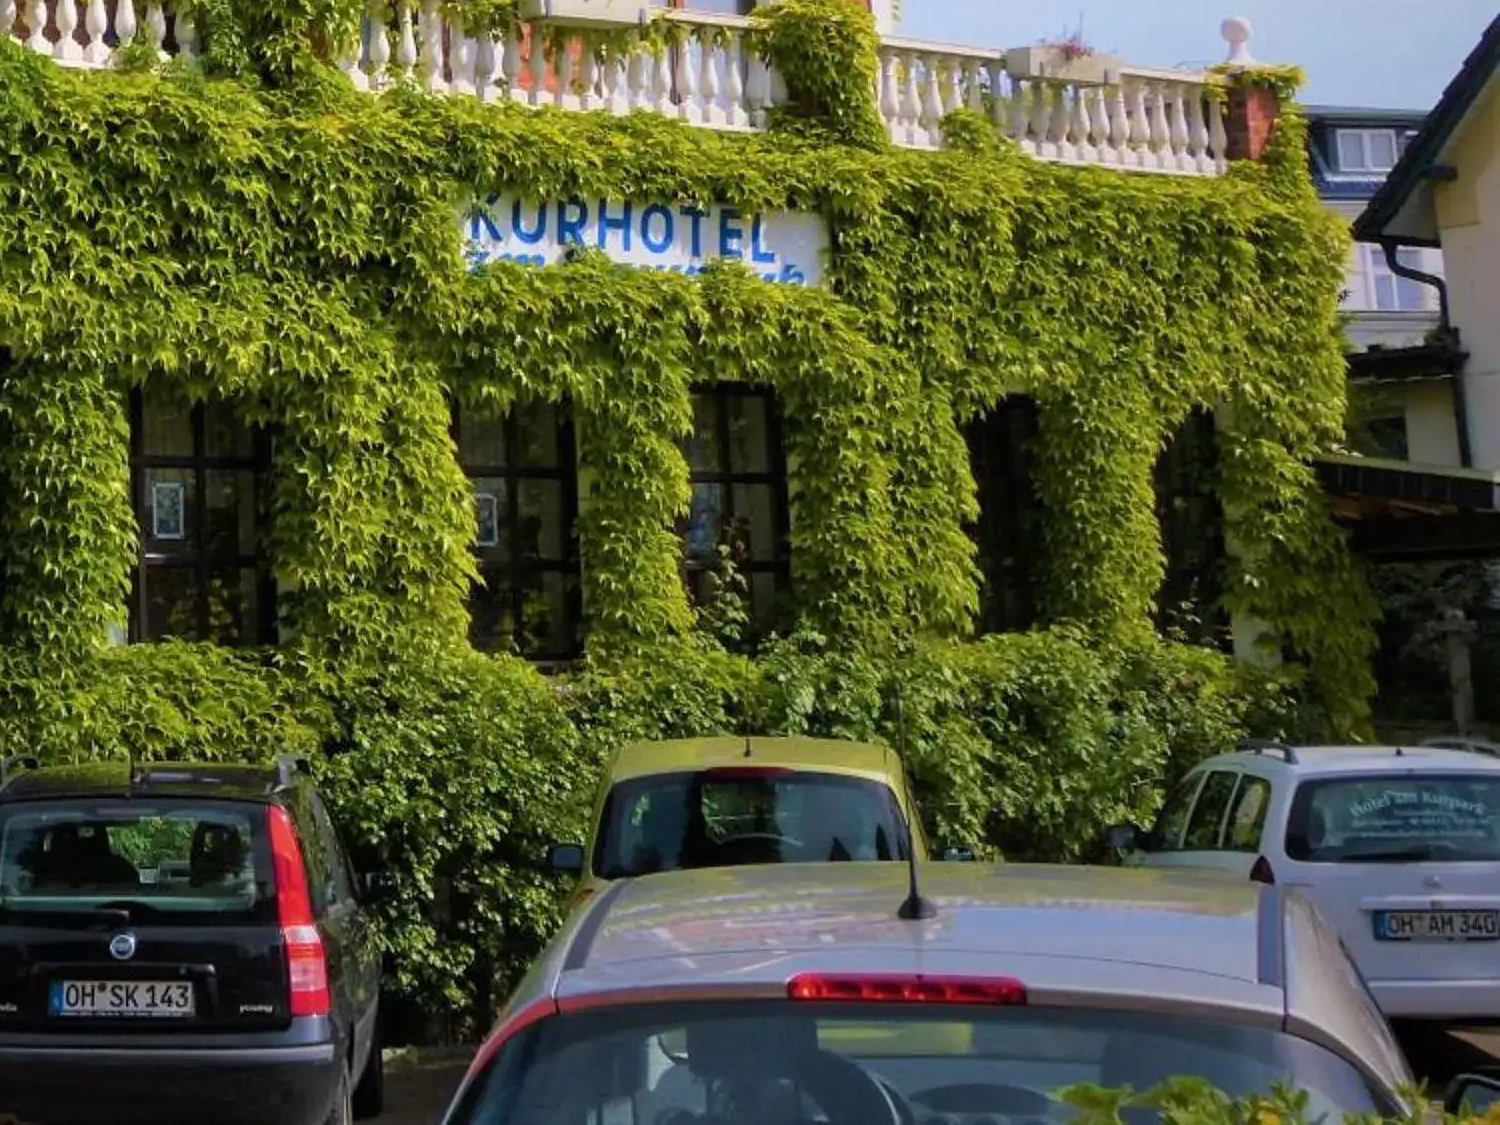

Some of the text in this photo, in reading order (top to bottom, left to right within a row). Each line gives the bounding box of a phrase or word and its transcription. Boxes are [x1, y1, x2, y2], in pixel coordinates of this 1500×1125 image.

[469, 193, 776, 263] KURHOTEL
[65, 984, 189, 1008] OH SK 143
